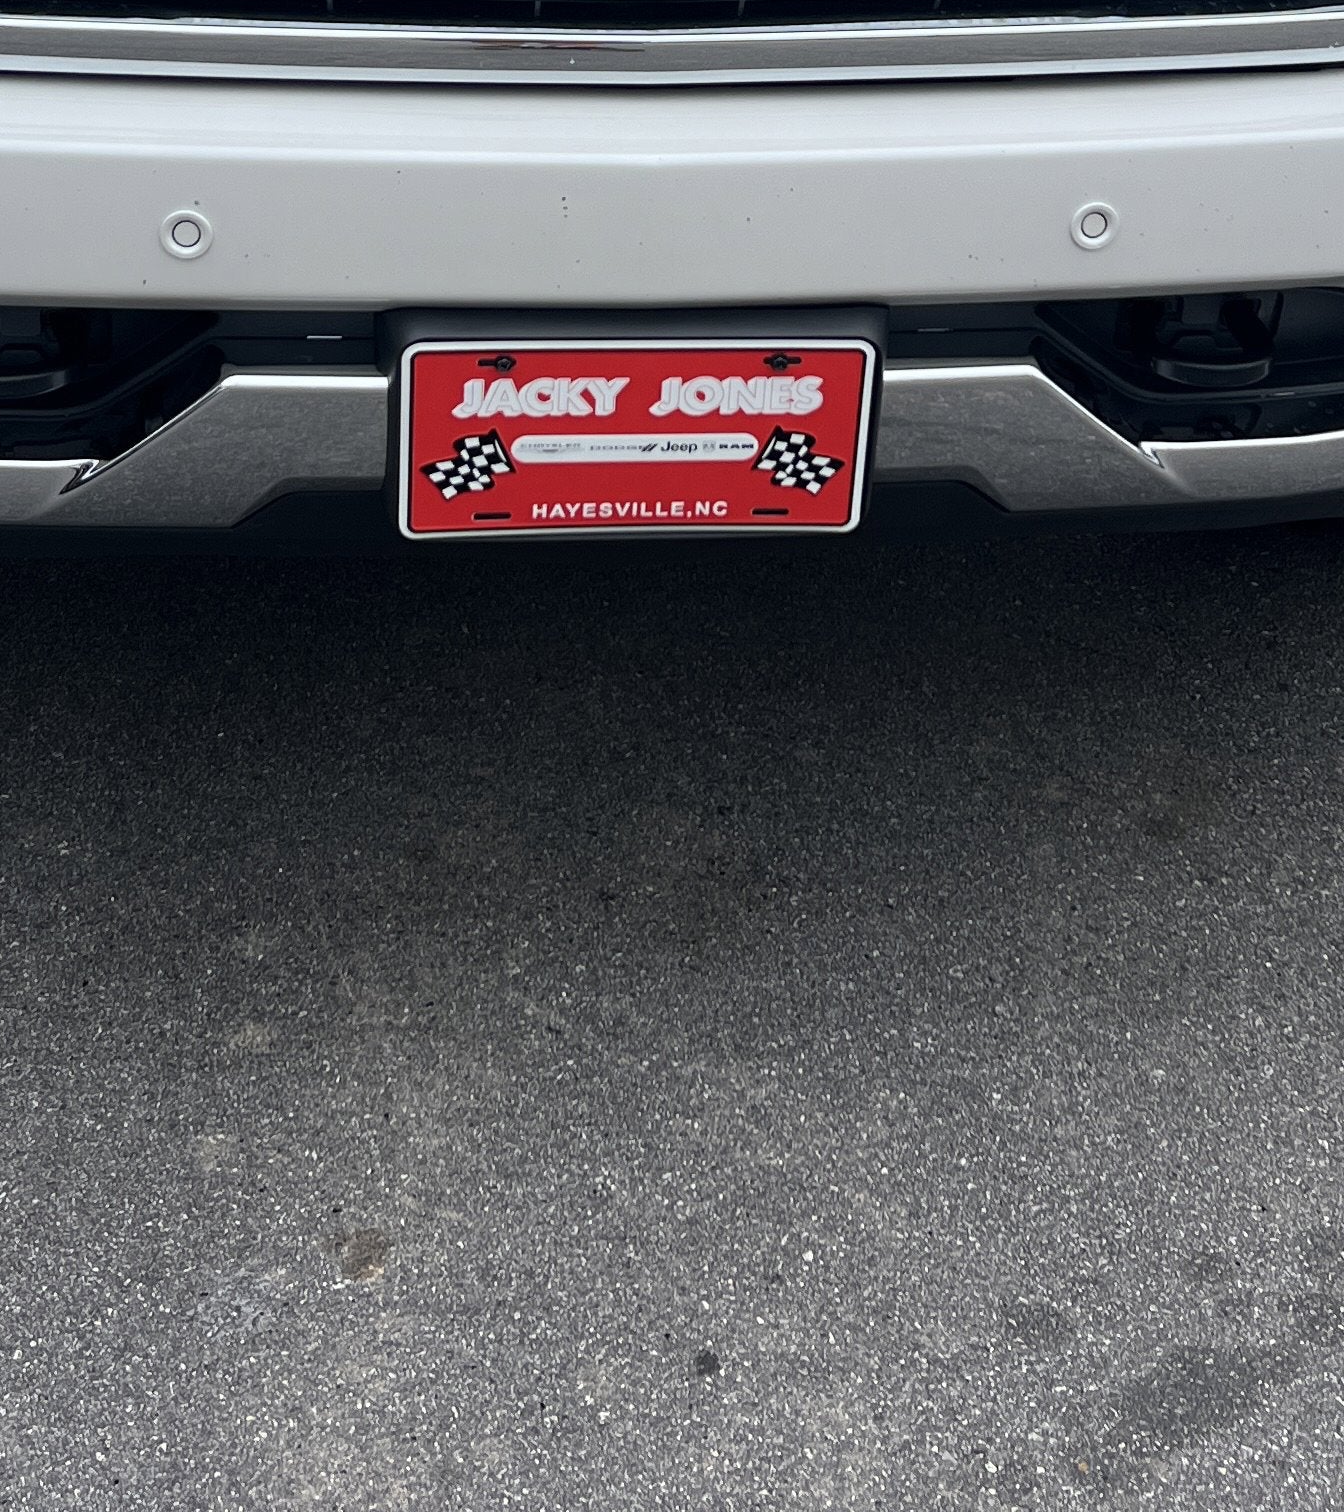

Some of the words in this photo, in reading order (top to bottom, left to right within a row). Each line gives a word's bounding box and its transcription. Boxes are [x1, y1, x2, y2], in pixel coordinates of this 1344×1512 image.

[451, 376, 631, 419] JACKY
[648, 375, 824, 418] JONES
[660, 441, 698, 454] Jeep
[532, 501, 728, 520] HAYESVILLE,NC
